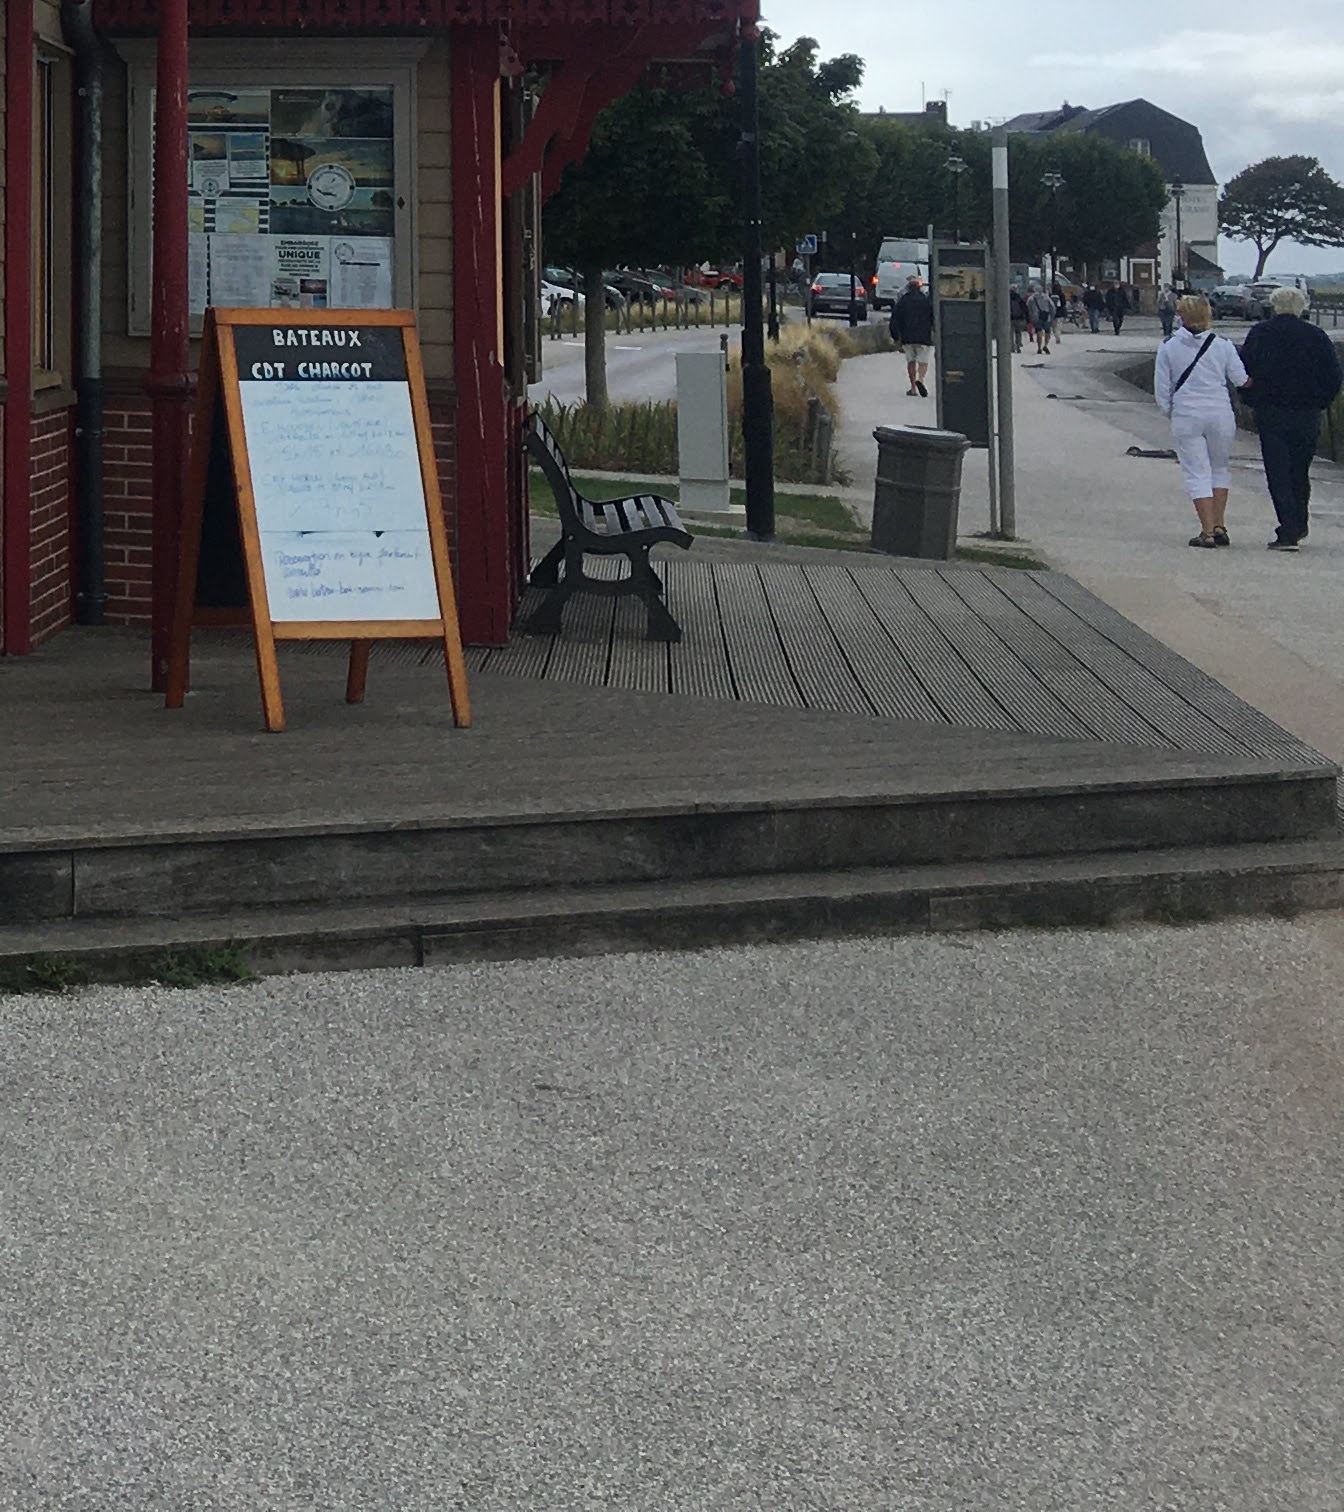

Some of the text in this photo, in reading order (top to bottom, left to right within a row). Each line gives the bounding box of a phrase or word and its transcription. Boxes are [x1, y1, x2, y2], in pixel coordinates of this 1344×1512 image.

[278, 250, 321, 259] UNIQUE
[272, 329, 362, 348] BATEAUX
[251, 362, 373, 380] CDT CHARCOT
